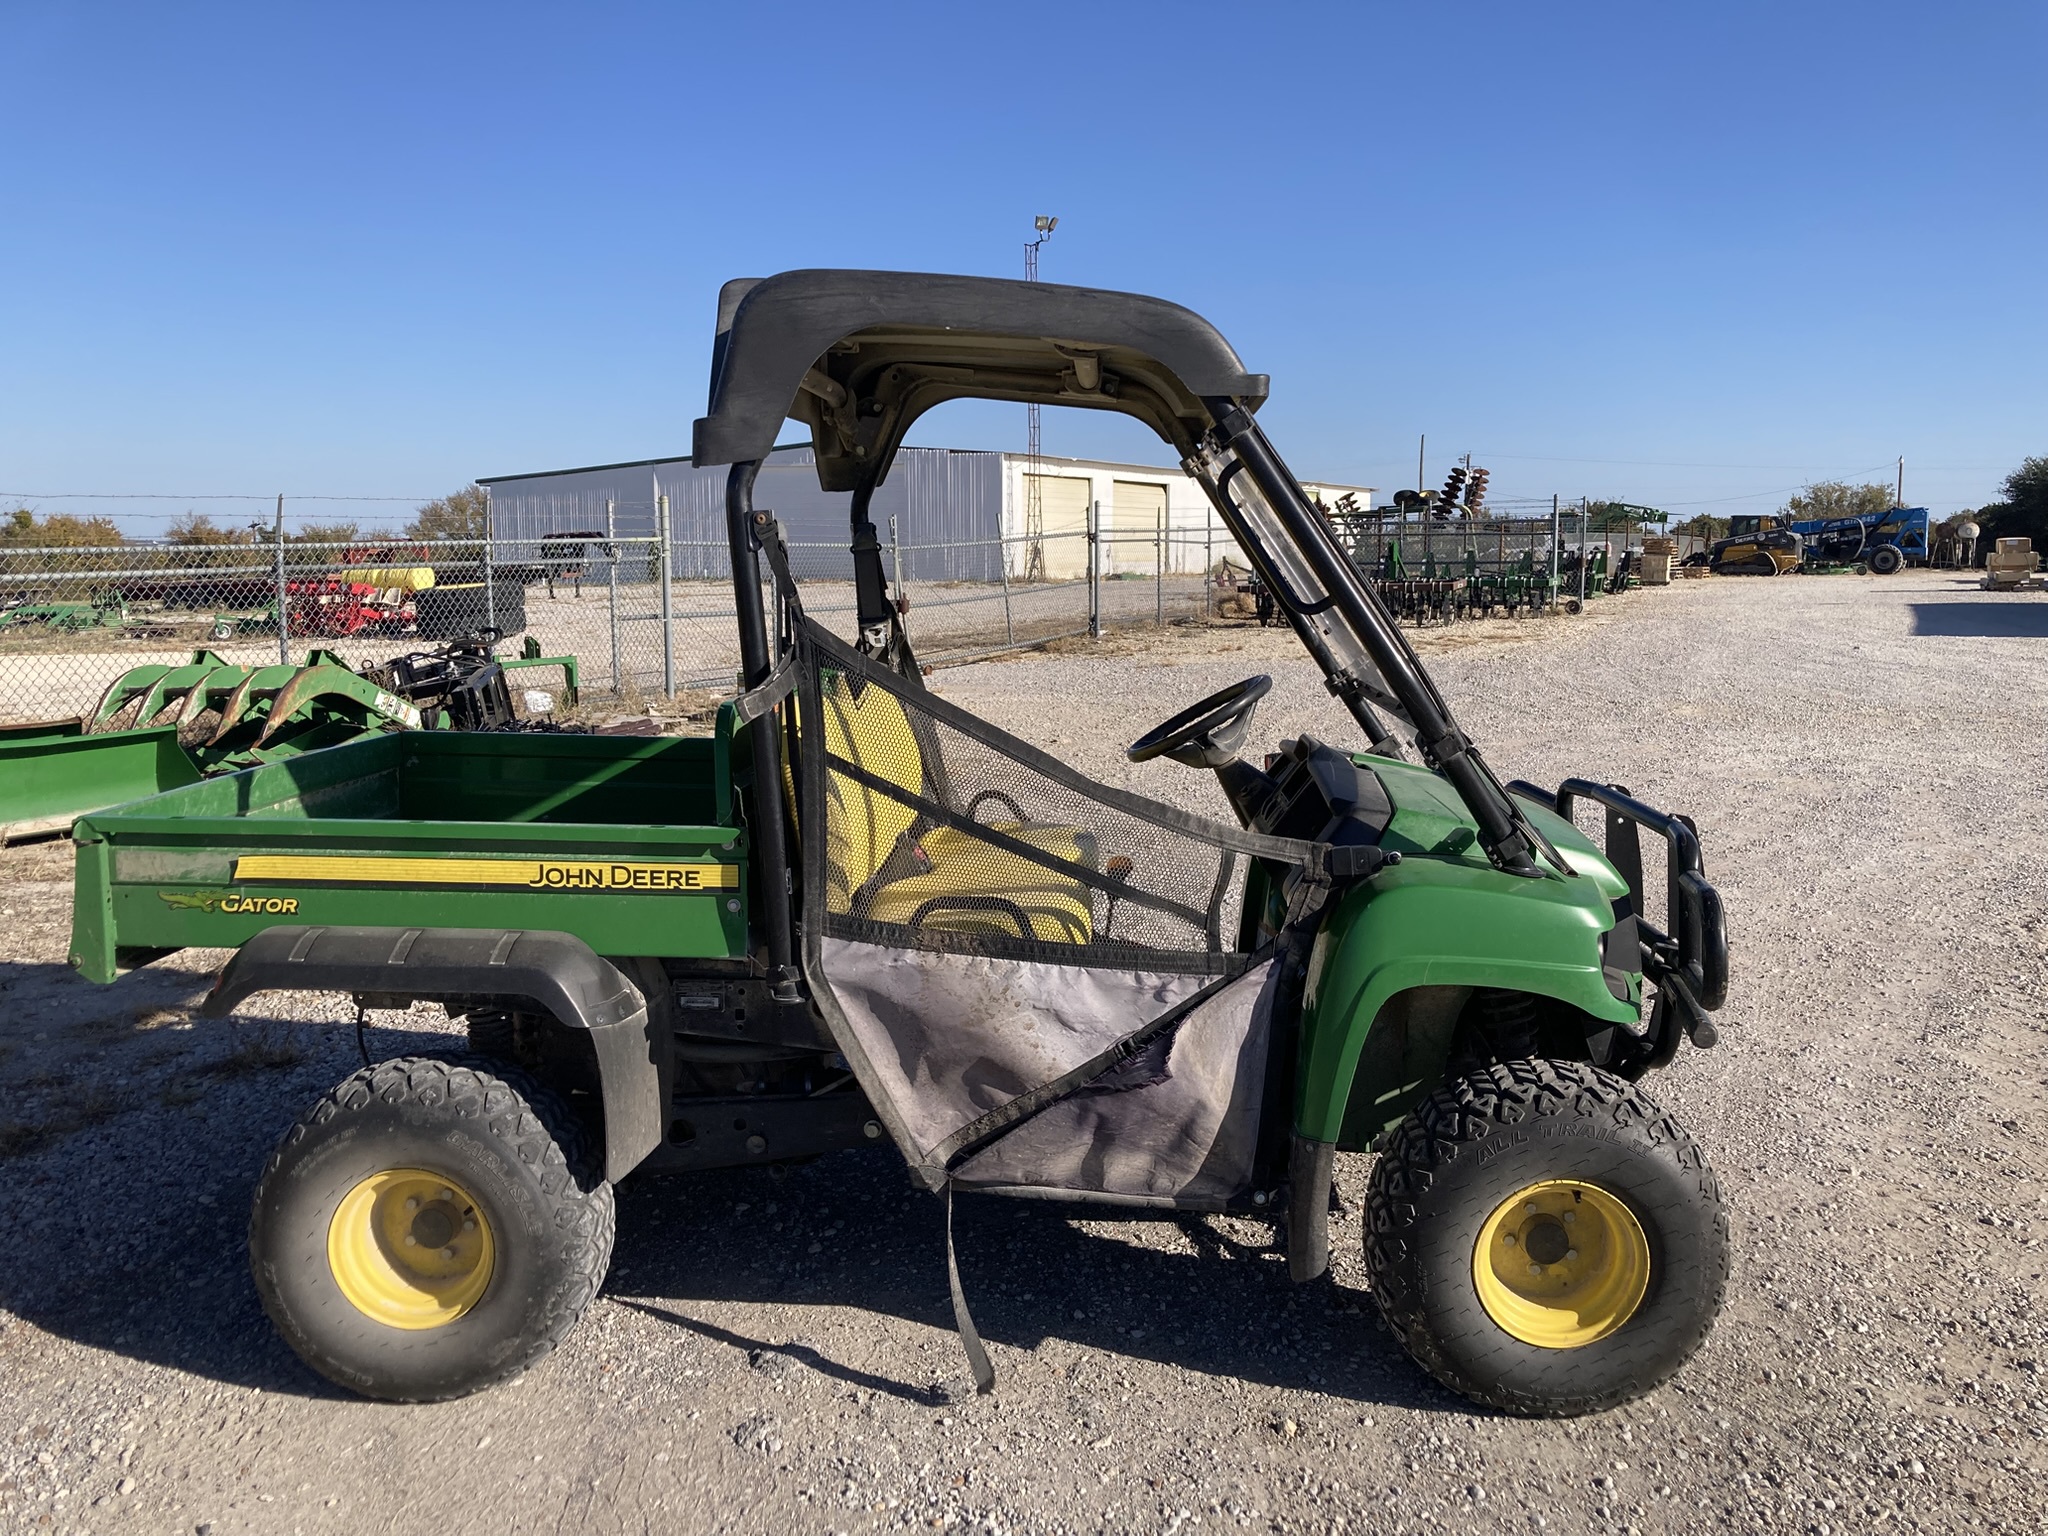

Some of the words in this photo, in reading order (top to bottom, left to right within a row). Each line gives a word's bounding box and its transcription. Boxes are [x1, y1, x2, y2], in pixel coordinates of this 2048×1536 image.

[1735, 535, 1755, 544] DEERE
[529, 863, 606, 888] JOHN
[610, 865, 703, 890] DEERE
[220, 894, 299, 915] GATOR
[1476, 1130, 1530, 1166] ALL
[1537, 1122, 1623, 1147] TRAIL
[446, 1129, 544, 1238] CARLISLE
